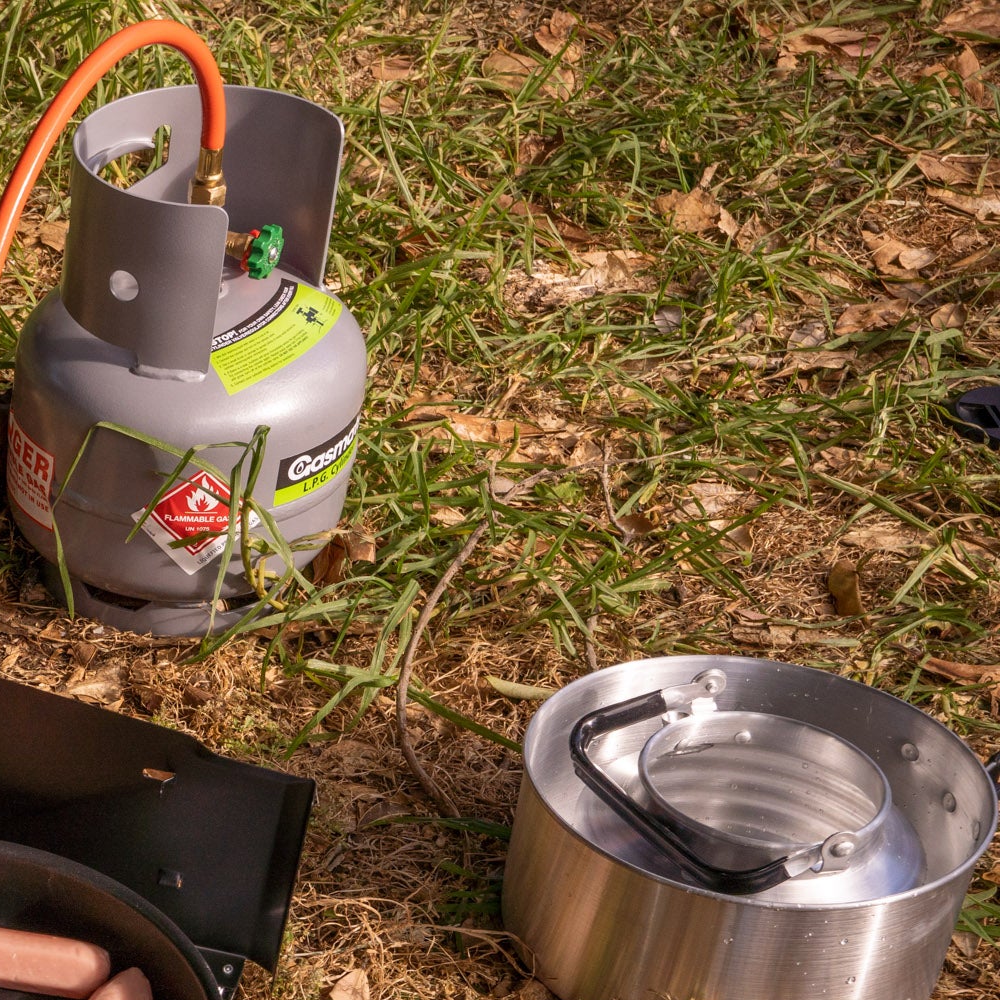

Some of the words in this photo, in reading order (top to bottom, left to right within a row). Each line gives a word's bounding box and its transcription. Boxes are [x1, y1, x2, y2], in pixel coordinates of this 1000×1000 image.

[211, 329, 239, 348] STOP!
[303, 471, 329, 493] L.P.G.
[164, 513, 215, 523] FLAMMABLE
